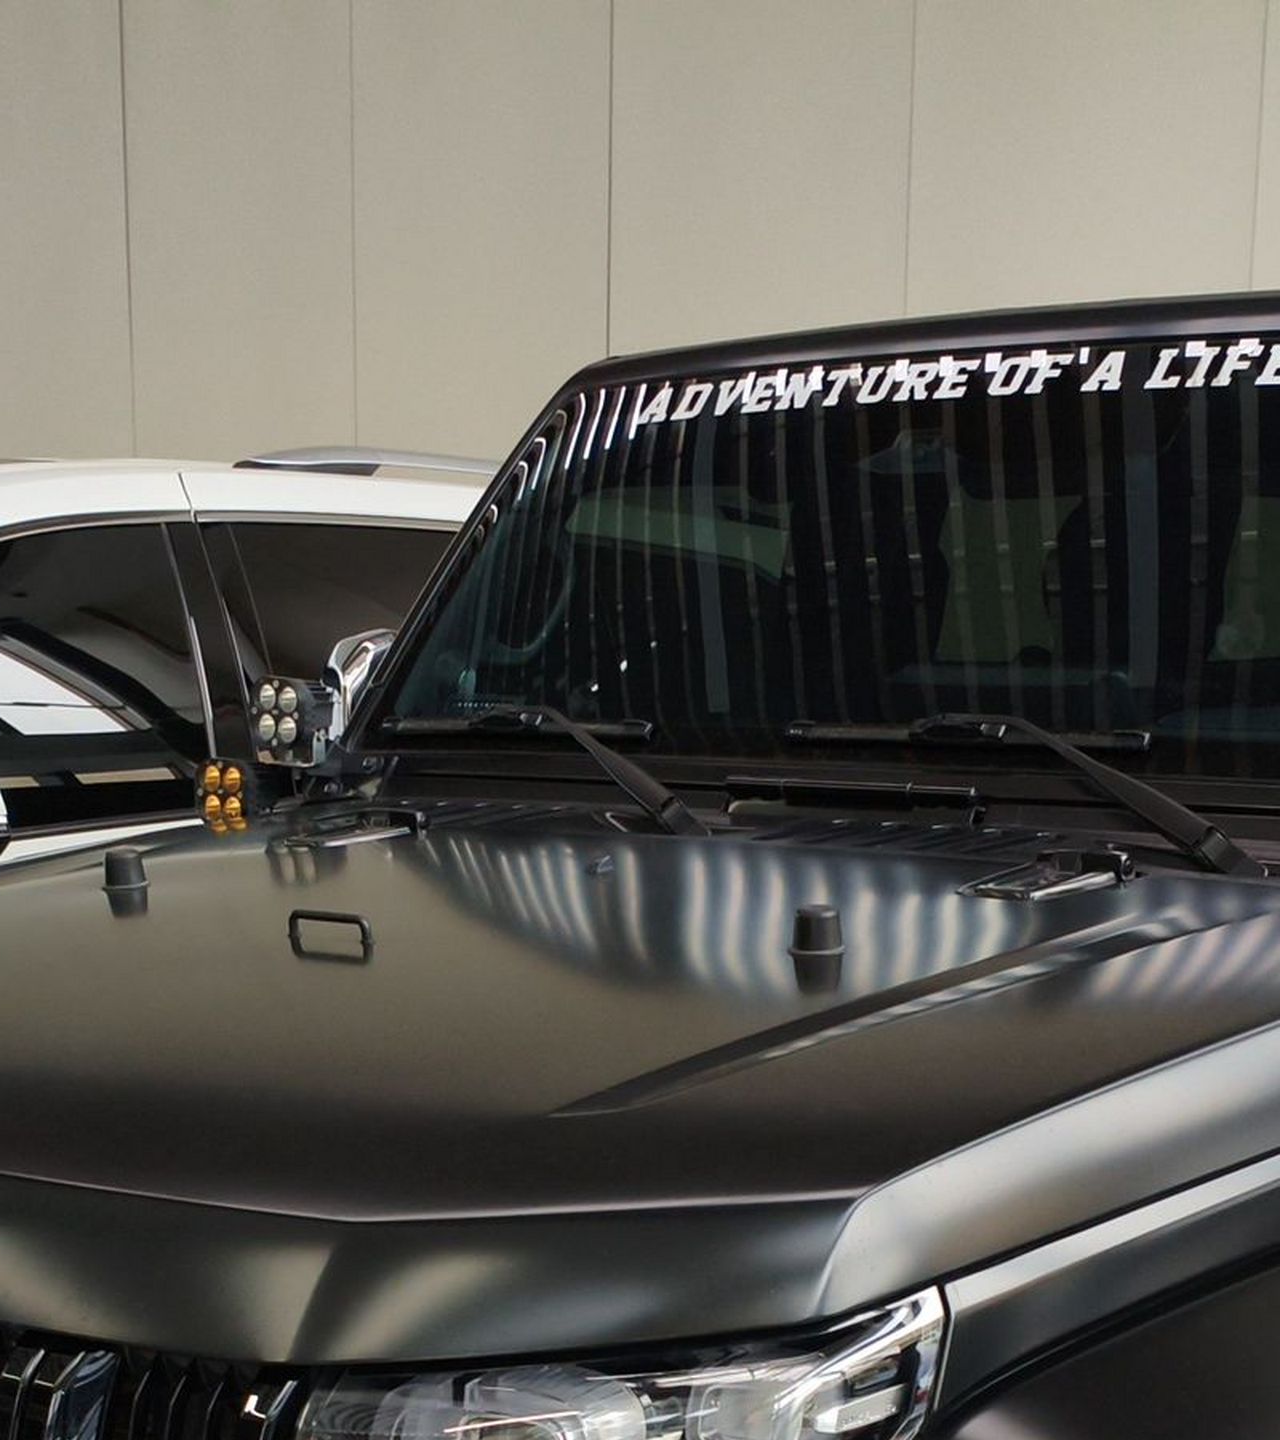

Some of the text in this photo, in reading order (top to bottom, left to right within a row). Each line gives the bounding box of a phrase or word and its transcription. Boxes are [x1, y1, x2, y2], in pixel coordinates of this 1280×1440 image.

[637, 358, 981, 425] ADVENTURE
[987, 352, 1074, 396] OF
[1080, 351, 1126, 392] A
